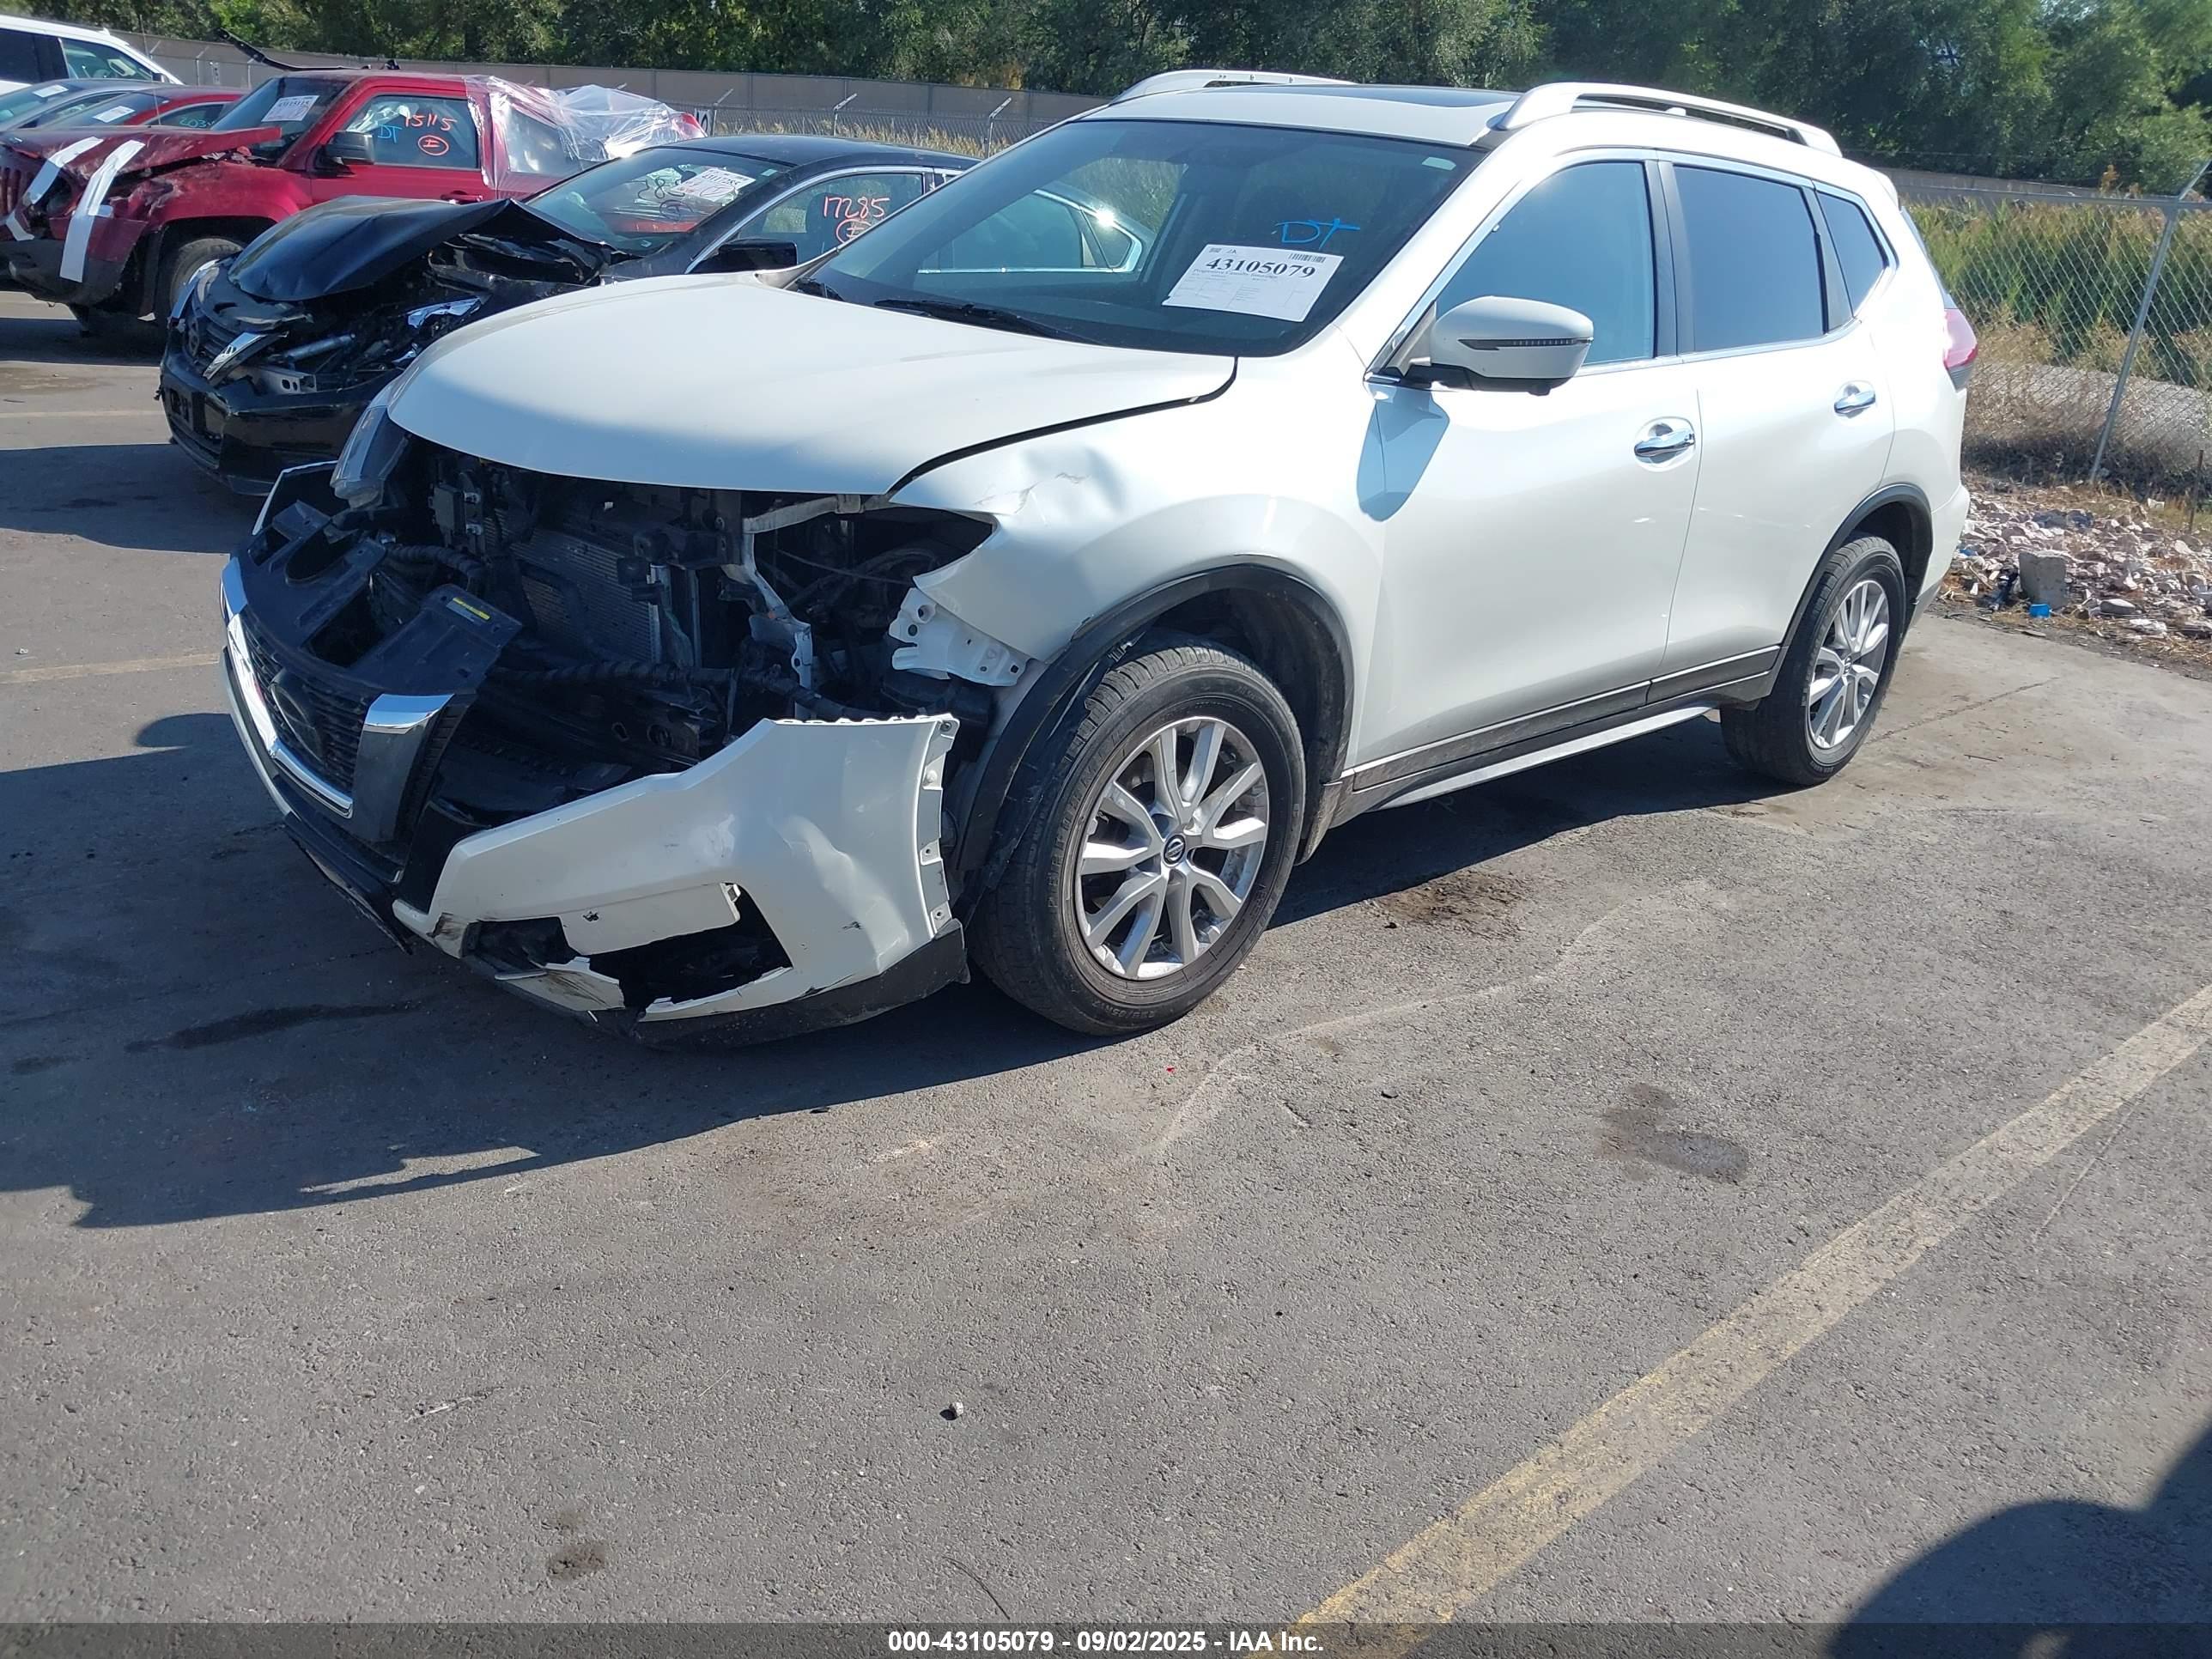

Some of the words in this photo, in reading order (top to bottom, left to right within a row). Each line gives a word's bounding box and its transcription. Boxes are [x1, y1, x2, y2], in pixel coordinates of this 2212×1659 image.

[378, 124, 403, 143] DT
[823, 196, 890, 219] 17285
[1274, 217, 1361, 251] DT
[1206, 257, 1316, 279] 43105079
